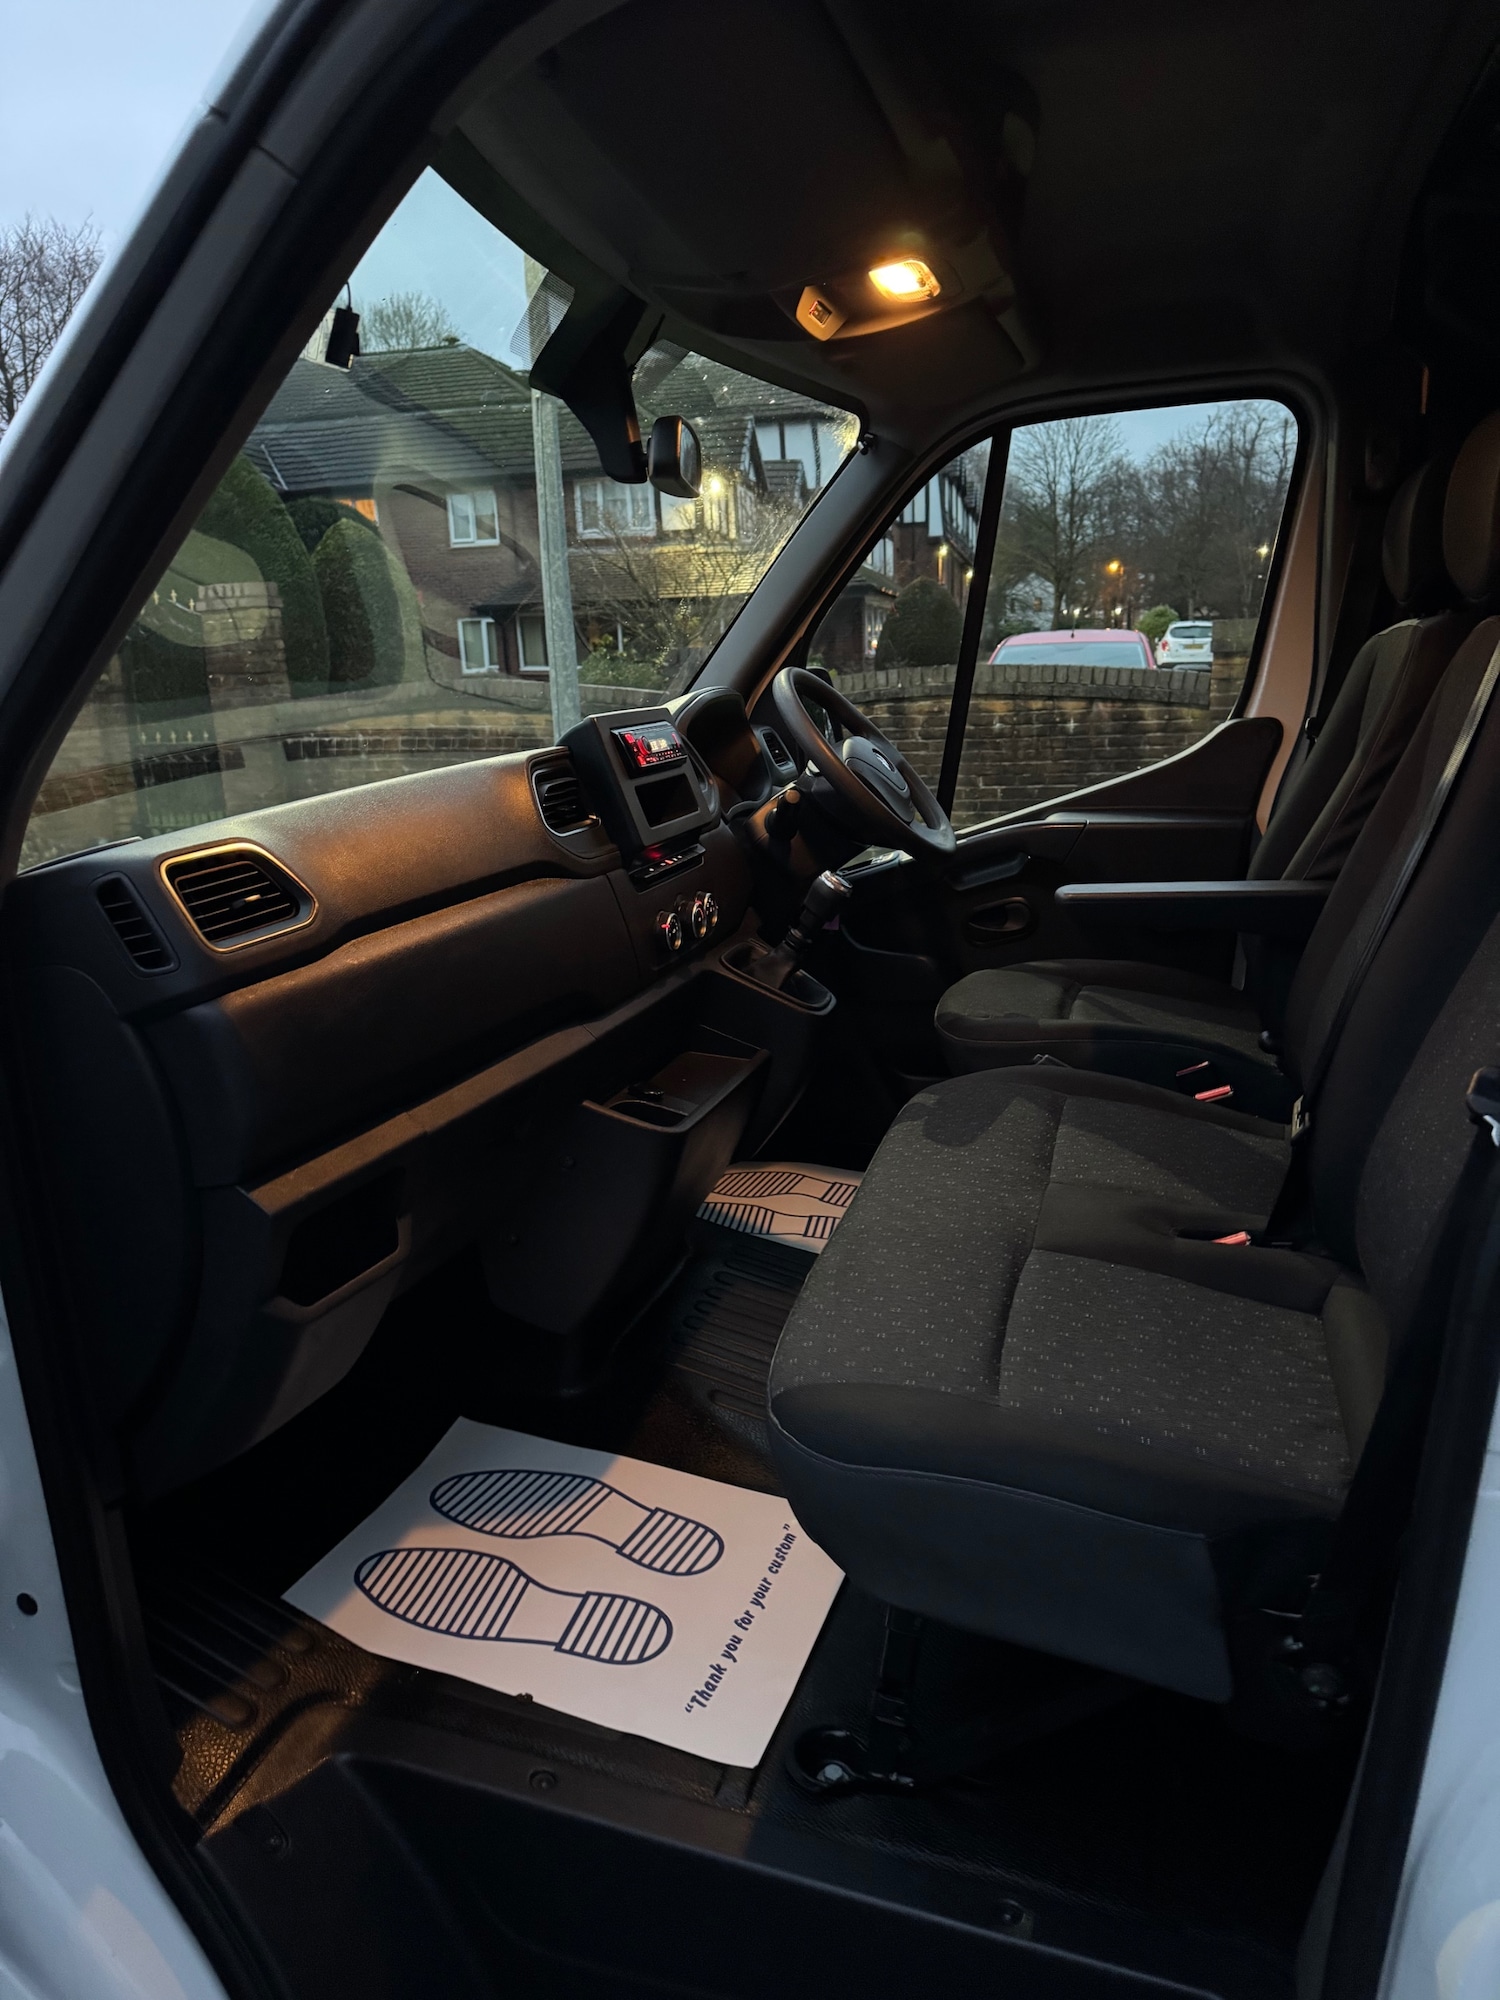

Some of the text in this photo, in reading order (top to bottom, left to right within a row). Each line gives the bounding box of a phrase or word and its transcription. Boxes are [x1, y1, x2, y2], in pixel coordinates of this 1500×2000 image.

[720, 1634, 743, 1664] you
[733, 1609, 755, 1631] for
[749, 1577, 773, 1610] your
